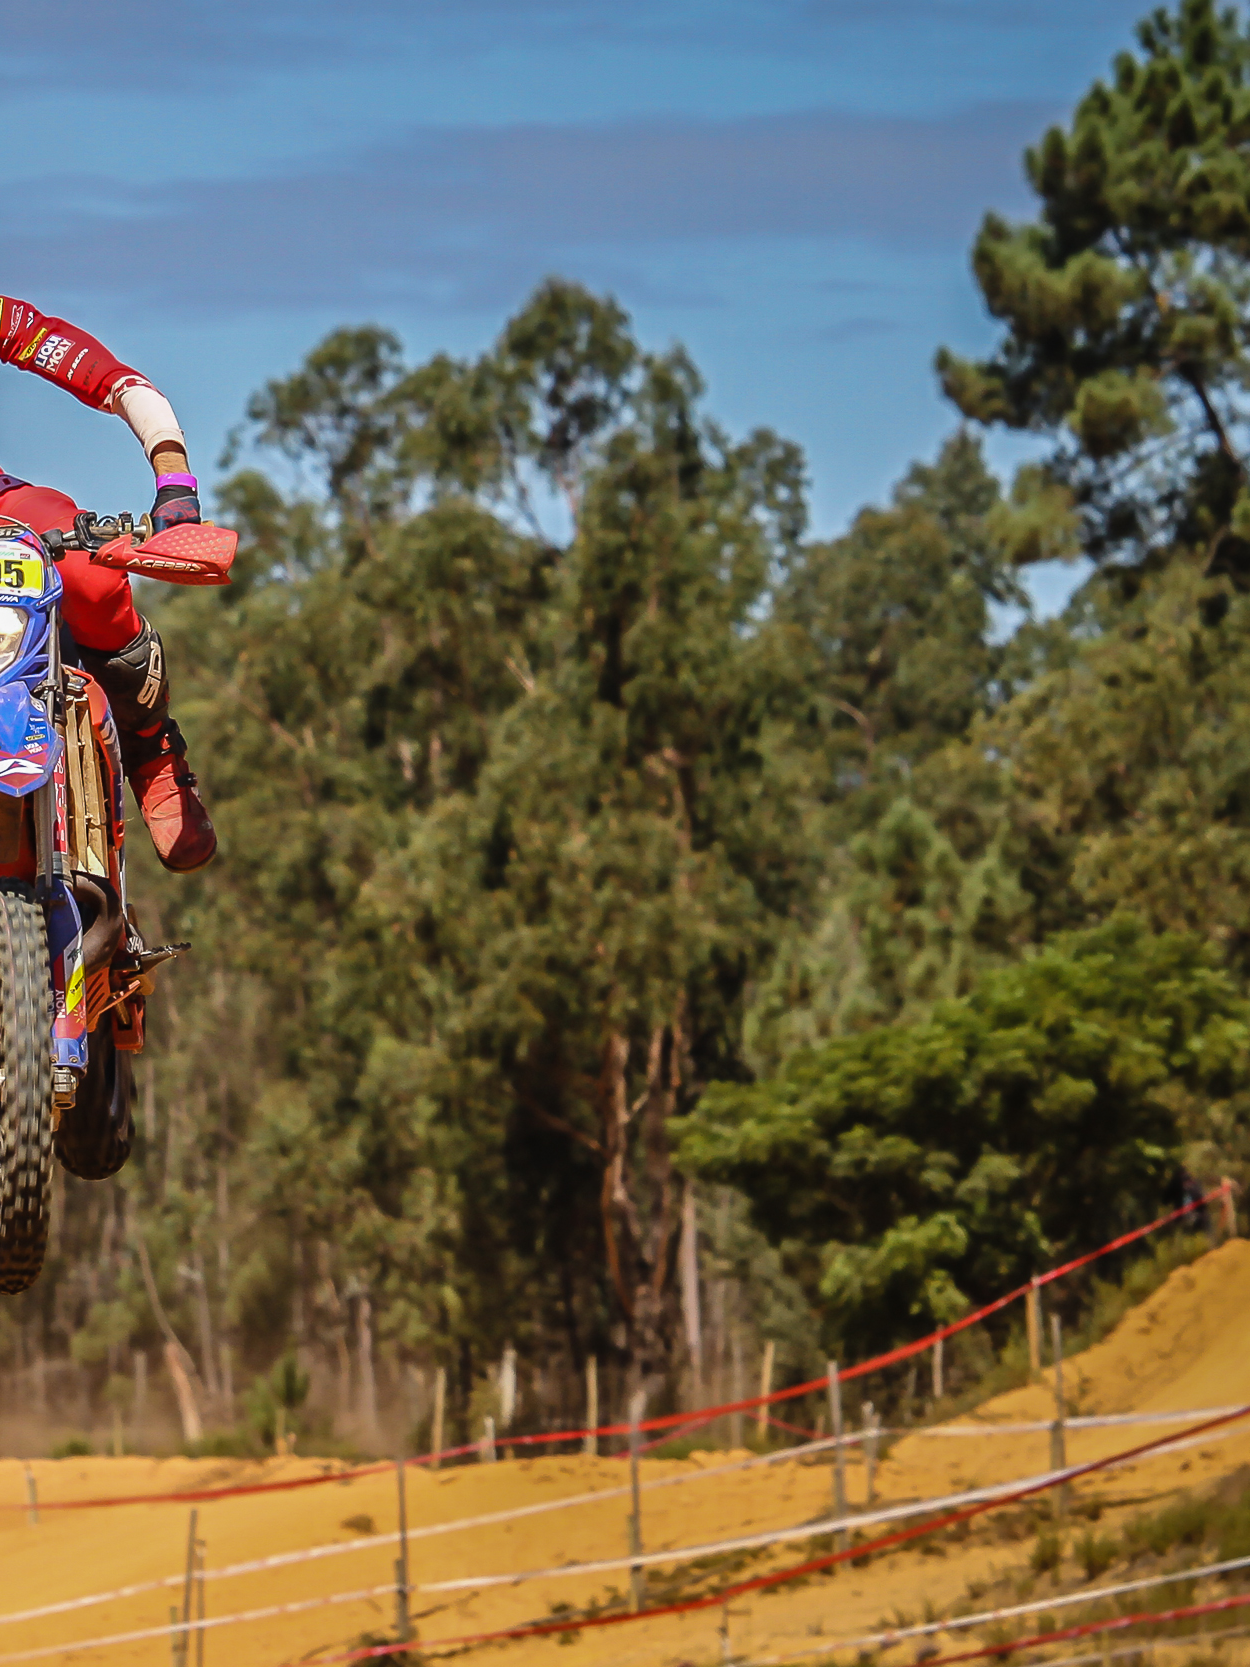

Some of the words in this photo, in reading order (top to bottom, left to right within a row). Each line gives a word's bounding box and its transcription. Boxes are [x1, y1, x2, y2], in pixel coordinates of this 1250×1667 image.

[35, 335, 62, 368] LIQUI
[46, 339, 72, 373] MOLY
[55, 989, 66, 1019] MOLY
